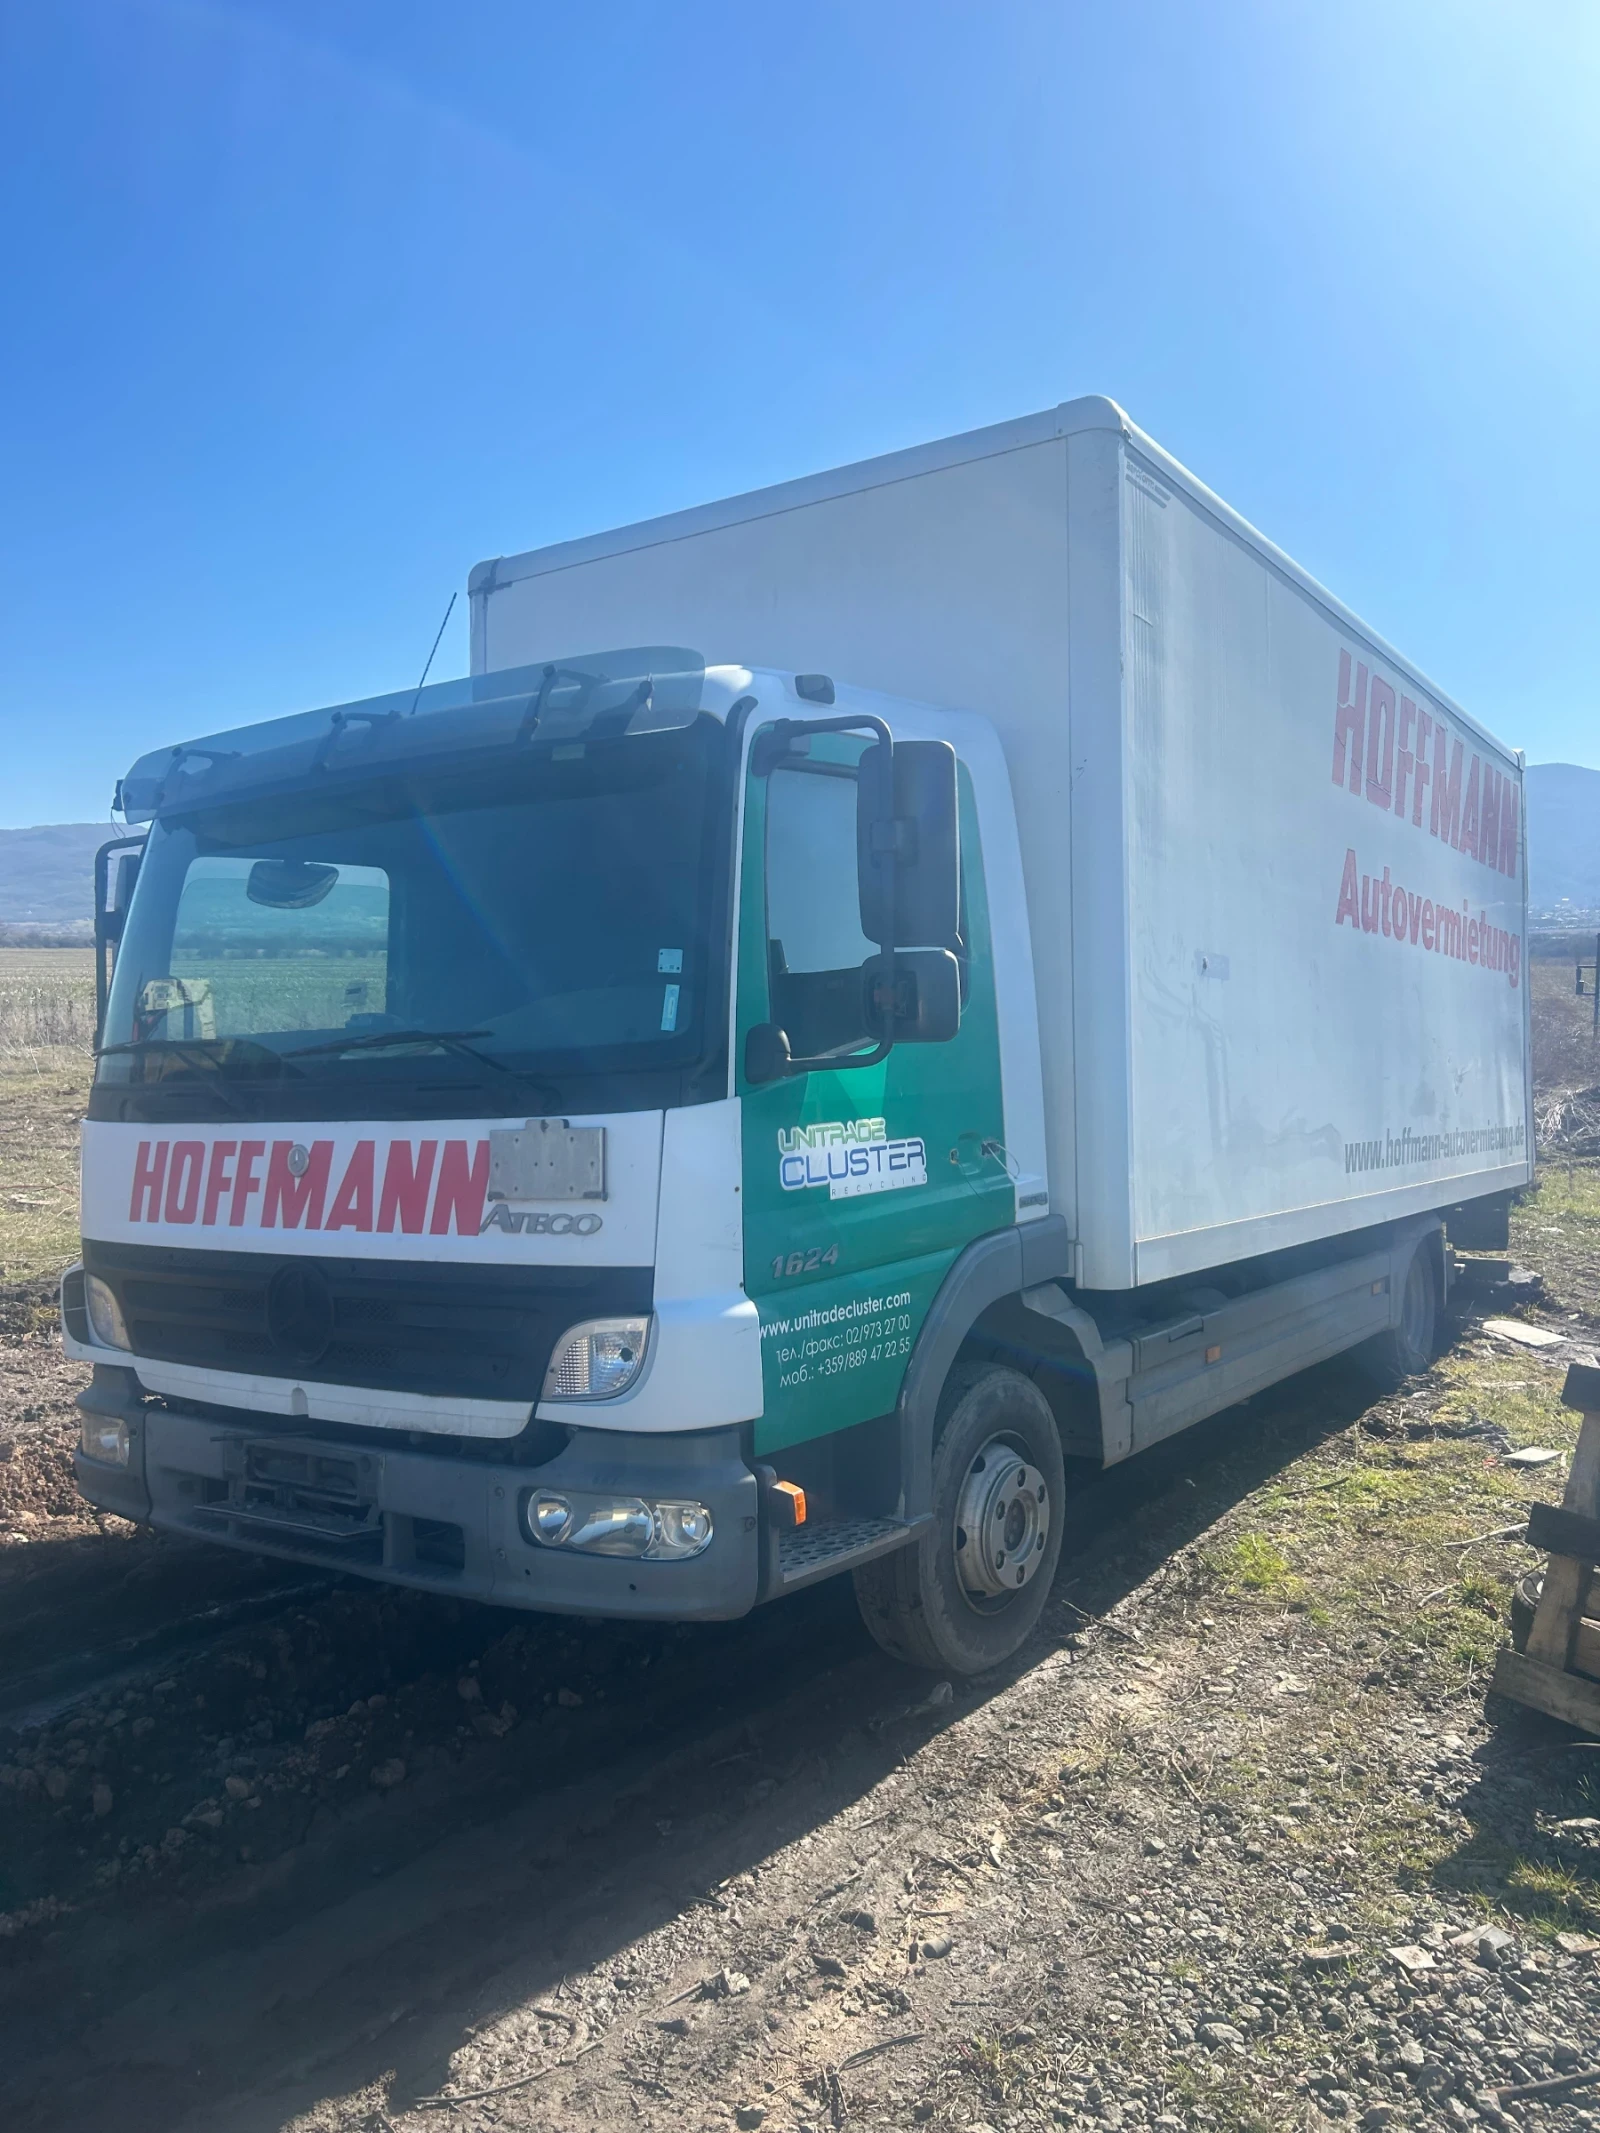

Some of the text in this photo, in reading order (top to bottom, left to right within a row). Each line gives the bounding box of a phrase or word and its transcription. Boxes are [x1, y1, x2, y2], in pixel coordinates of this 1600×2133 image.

[1332, 647, 1519, 879] HOFFMANN
[1335, 848, 1520, 988] Autovermietung
[779, 1120, 885, 1152] UNITRADE
[782, 1141, 925, 1187] CLUSTER
[832, 1174, 926, 1196] RECYCLING
[129, 1140, 490, 1236] HOFFMANN
[771, 1243, 839, 1278] 1624
[759, 1291, 911, 1339] www.unitradecluster.com
[846, 1322, 882, 1345] 02/973
[884, 1317, 896, 1335] 27
[898, 1314, 910, 1331] 00
[780, 1363, 814, 1387] моб.:
[818, 1348, 867, 1375] +359/889
[870, 1344, 882, 1361] 47
[884, 1341, 897, 1358] 22
